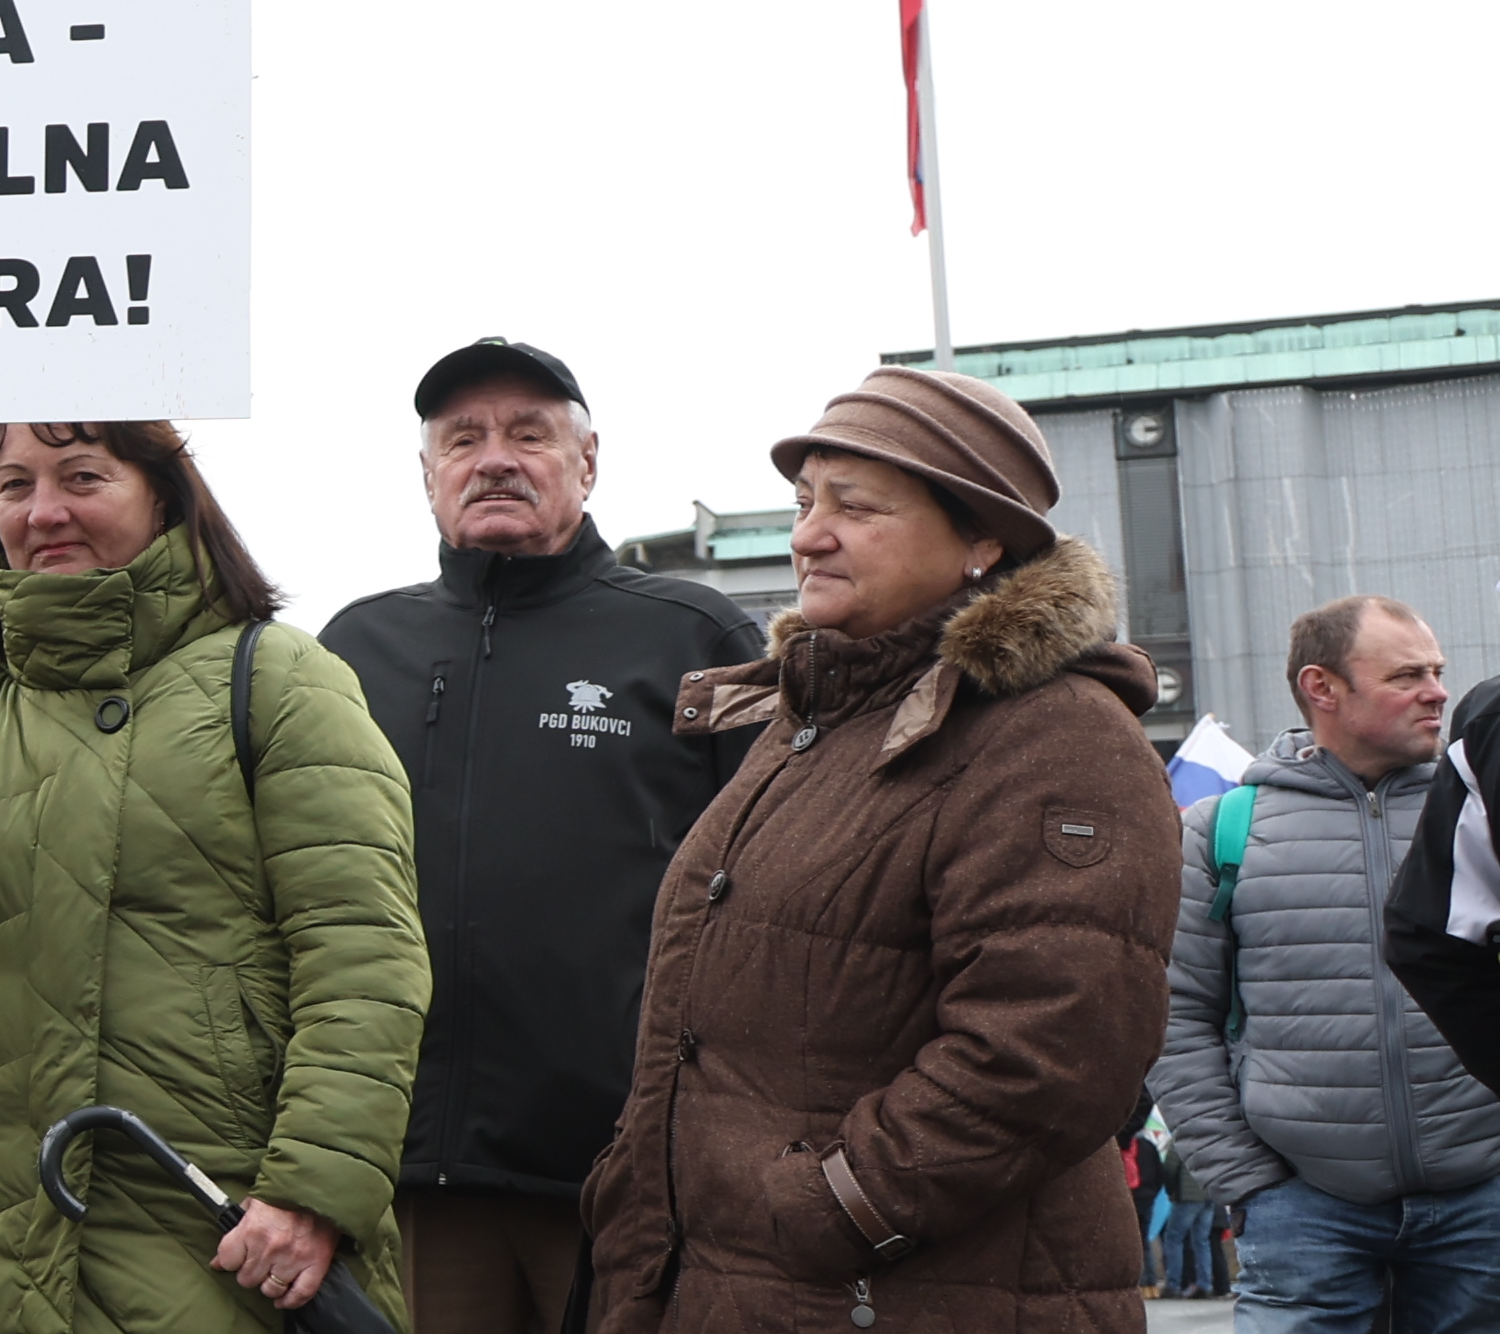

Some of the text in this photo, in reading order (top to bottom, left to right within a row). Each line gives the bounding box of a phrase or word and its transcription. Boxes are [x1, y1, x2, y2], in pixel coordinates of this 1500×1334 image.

[69, 23, 106, 42] -
[538, 712, 631, 737] PGD BUKOVCI
[570, 733, 597, 749] 1910
